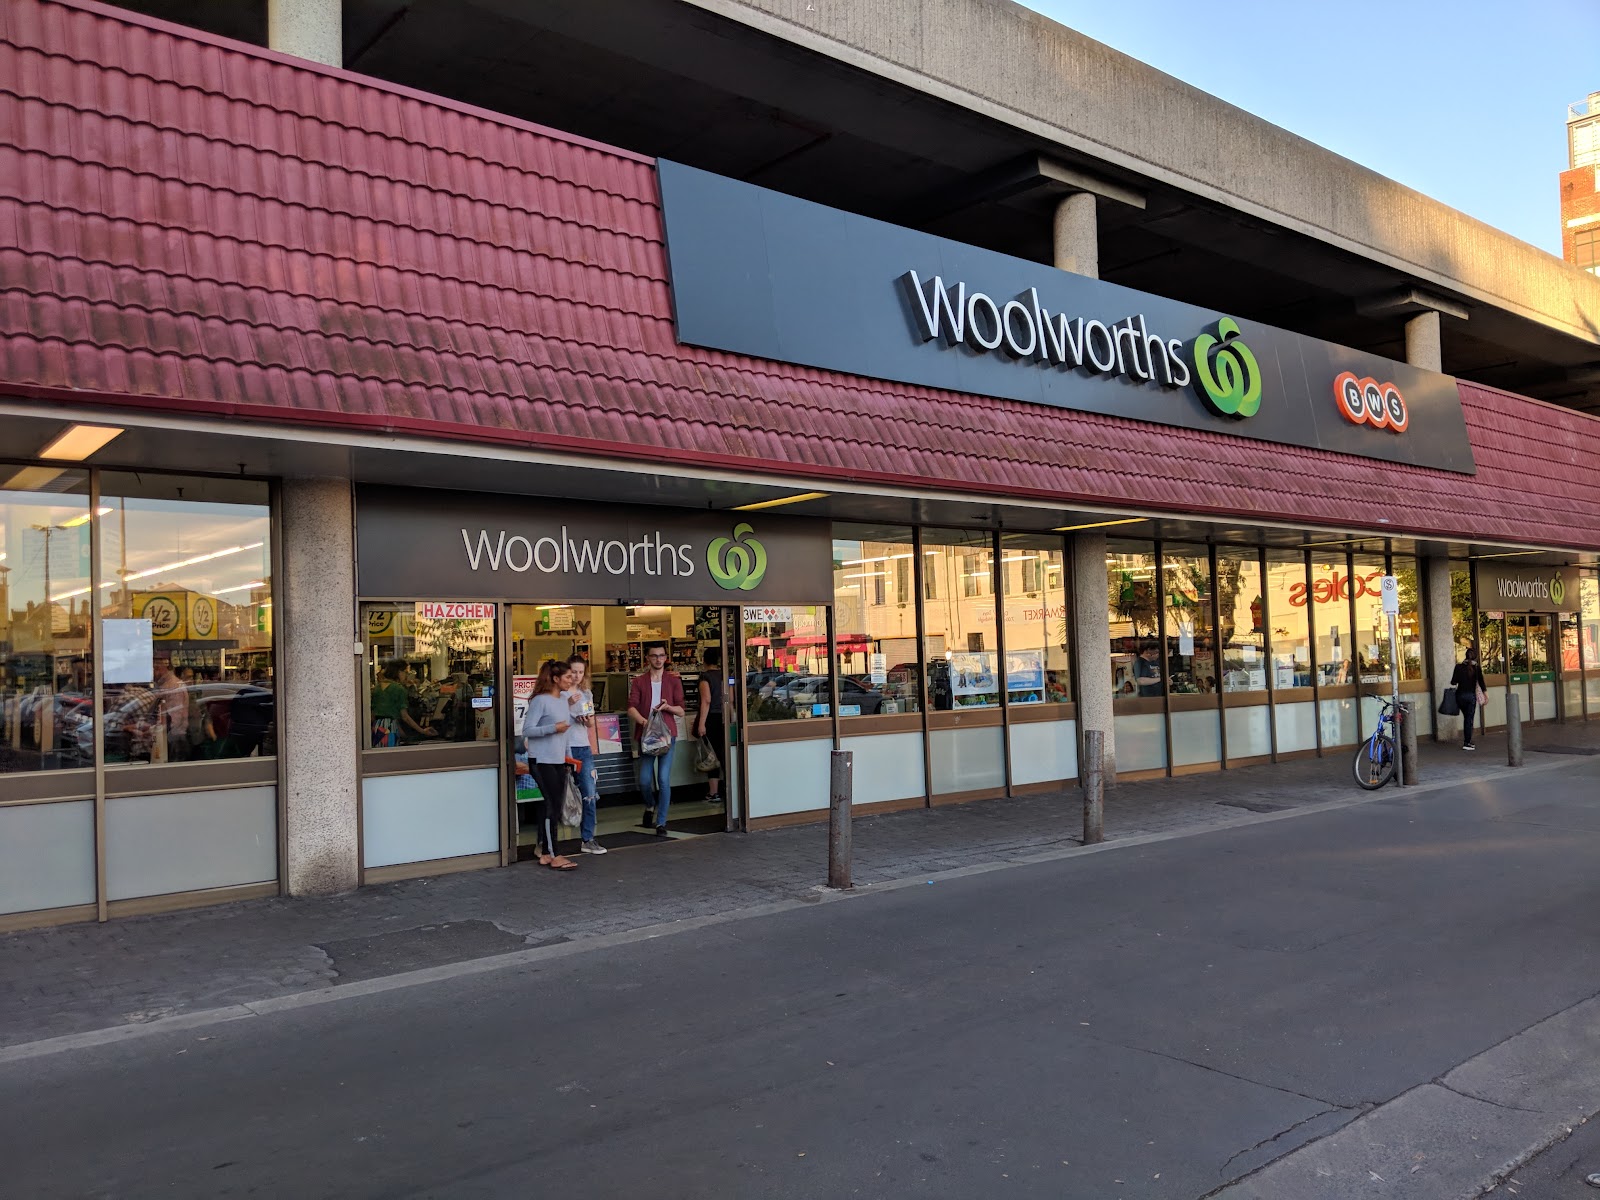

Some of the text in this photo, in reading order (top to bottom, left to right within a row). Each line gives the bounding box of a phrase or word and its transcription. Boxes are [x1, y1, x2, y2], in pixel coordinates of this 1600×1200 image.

[907, 270, 1190, 387] Woolworths
[461, 525, 695, 577] Woolworths
[1497, 575, 1548, 599] Woolworths
[149, 605, 171, 622] 1/2
[424, 604, 494, 618] HAZCHEM
